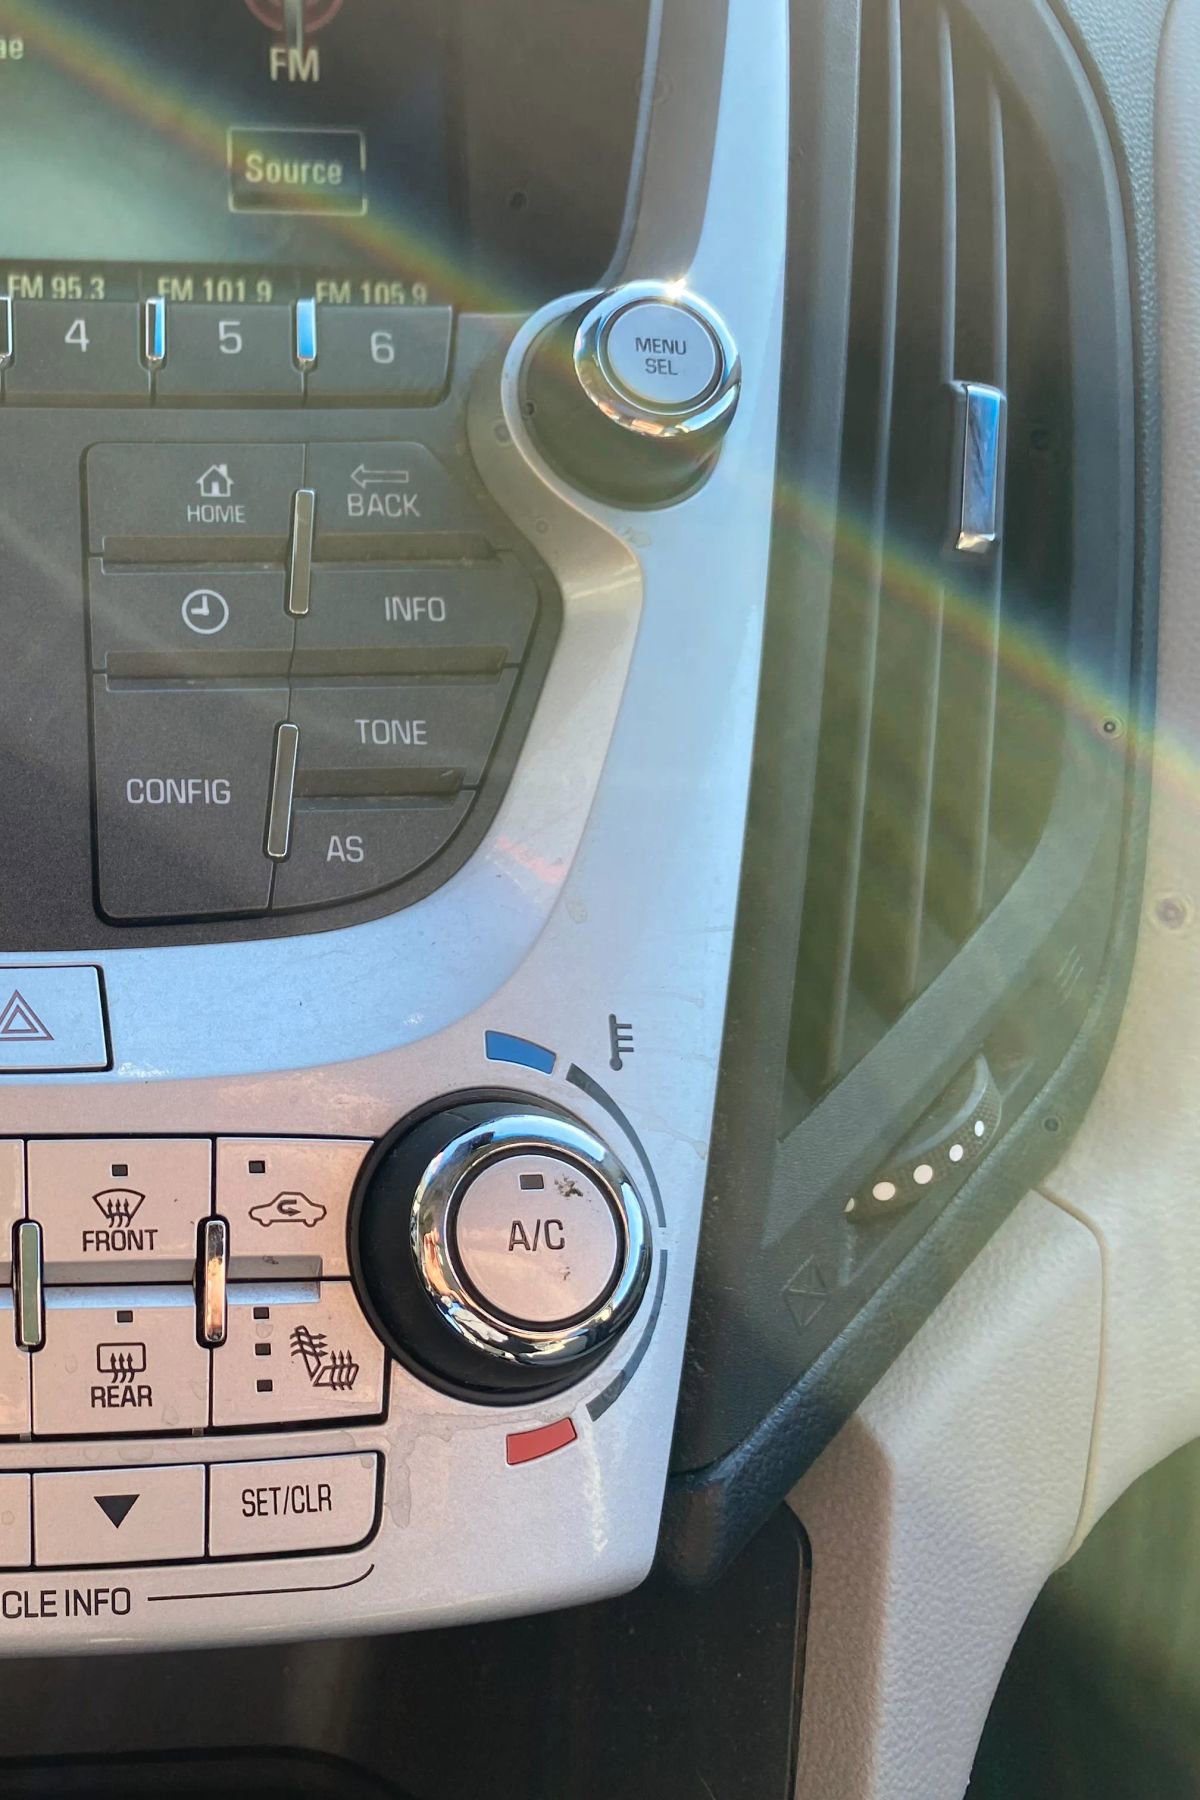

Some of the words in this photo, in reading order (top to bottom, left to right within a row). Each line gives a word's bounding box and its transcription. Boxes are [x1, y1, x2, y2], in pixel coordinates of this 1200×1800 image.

[270, 49, 319, 82] FM
[245, 154, 342, 185] Source
[7, 274, 43, 298] FM
[158, 277, 193, 301] FM
[204, 278, 272, 302] 1019
[316, 280, 350, 303] FM
[361, 281, 427, 305] 1059
[64, 319, 89, 352] 4
[219, 321, 243, 354] 5
[370, 331, 395, 364] 6
[635, 337, 687, 355] MENU
[645, 358, 678, 376] SEL
[186, 504, 246, 523] HOME
[347, 494, 421, 518] BACK
[384, 596, 447, 622] INFO
[354, 719, 428, 746] TONE
[125, 778, 232, 805] CONFIG
[326, 836, 365, 863] AS
[82, 1229, 159, 1252] FRONT
[508, 1218, 566, 1252] A/C
[91, 1385, 153, 1408] REAR
[241, 1483, 333, 1518] SET/CLR
[64, 1587, 133, 1617] INFO
